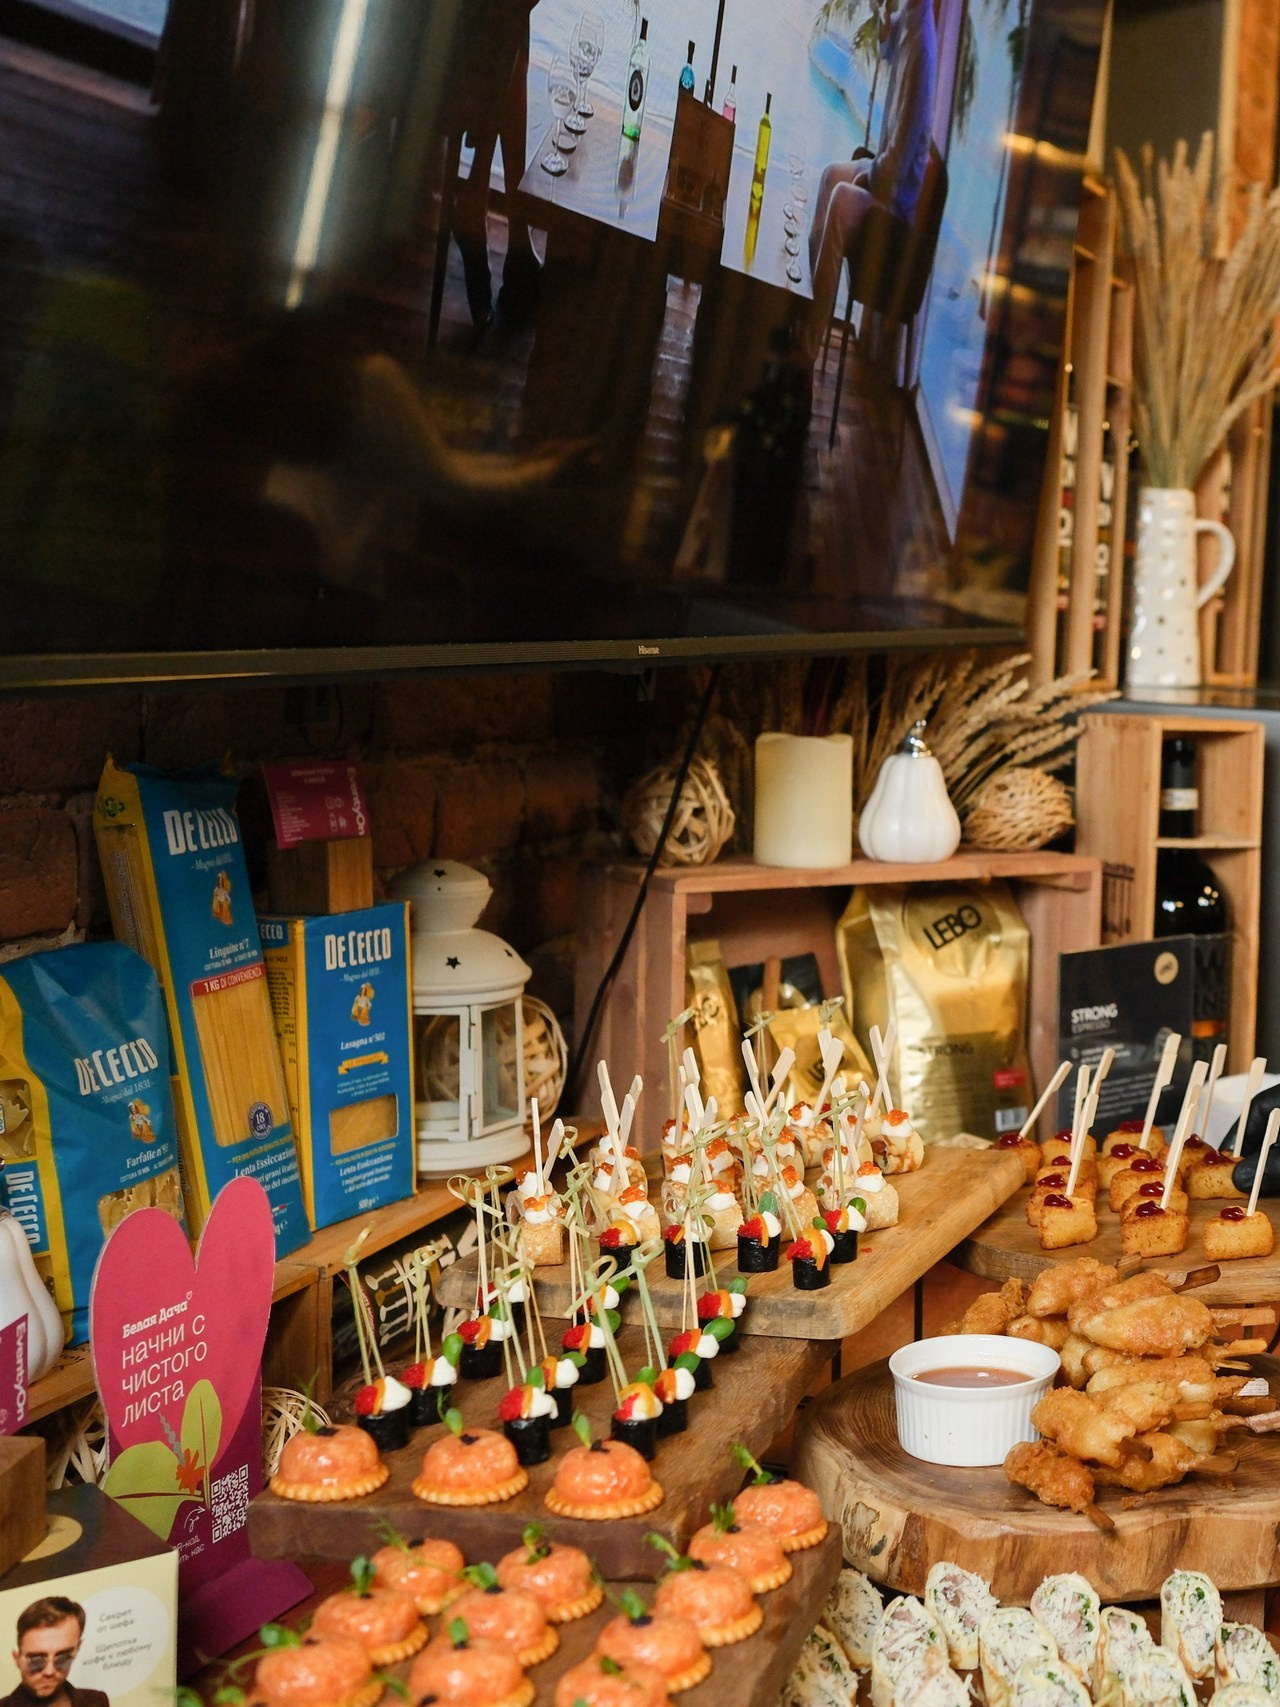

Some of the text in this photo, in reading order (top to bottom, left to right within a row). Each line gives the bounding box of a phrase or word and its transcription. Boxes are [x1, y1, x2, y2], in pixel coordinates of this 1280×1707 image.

[923, 904, 983, 950] LEBO
[209, 942, 239, 960] Linguine
[325, 927, 392, 971] DE CECCO
[209, 977, 220, 991] KG
[221, 976, 228, 988] DI
[227, 968, 263, 986] CONVENIENZA
[1071, 1003, 1118, 1024] STRONG
[340, 1037, 368, 1050] Lasagna
[74, 1038, 158, 1096] DE CECCO
[256, 1113, 265, 1123] 18
[126, 1149, 157, 1169] Farfalle
[235, 1147, 297, 1179] Lenta Essiccazion
[5, 1170, 35, 1196] DE
[271, 1179, 282, 1189] del
[122, 1299, 188, 1339] Белая Дача
[121, 1322, 185, 1370] начни
[192, 1314, 206, 1335] с
[14, 1321, 26, 1421] EventyOn
[121, 1341, 208, 1396] чистого
[121, 1379, 185, 1428] листа
[191, 1543, 205, 1557] нас
[99, 1609, 132, 1623] Секрет
[82, 1655, 106, 1666] кофе
